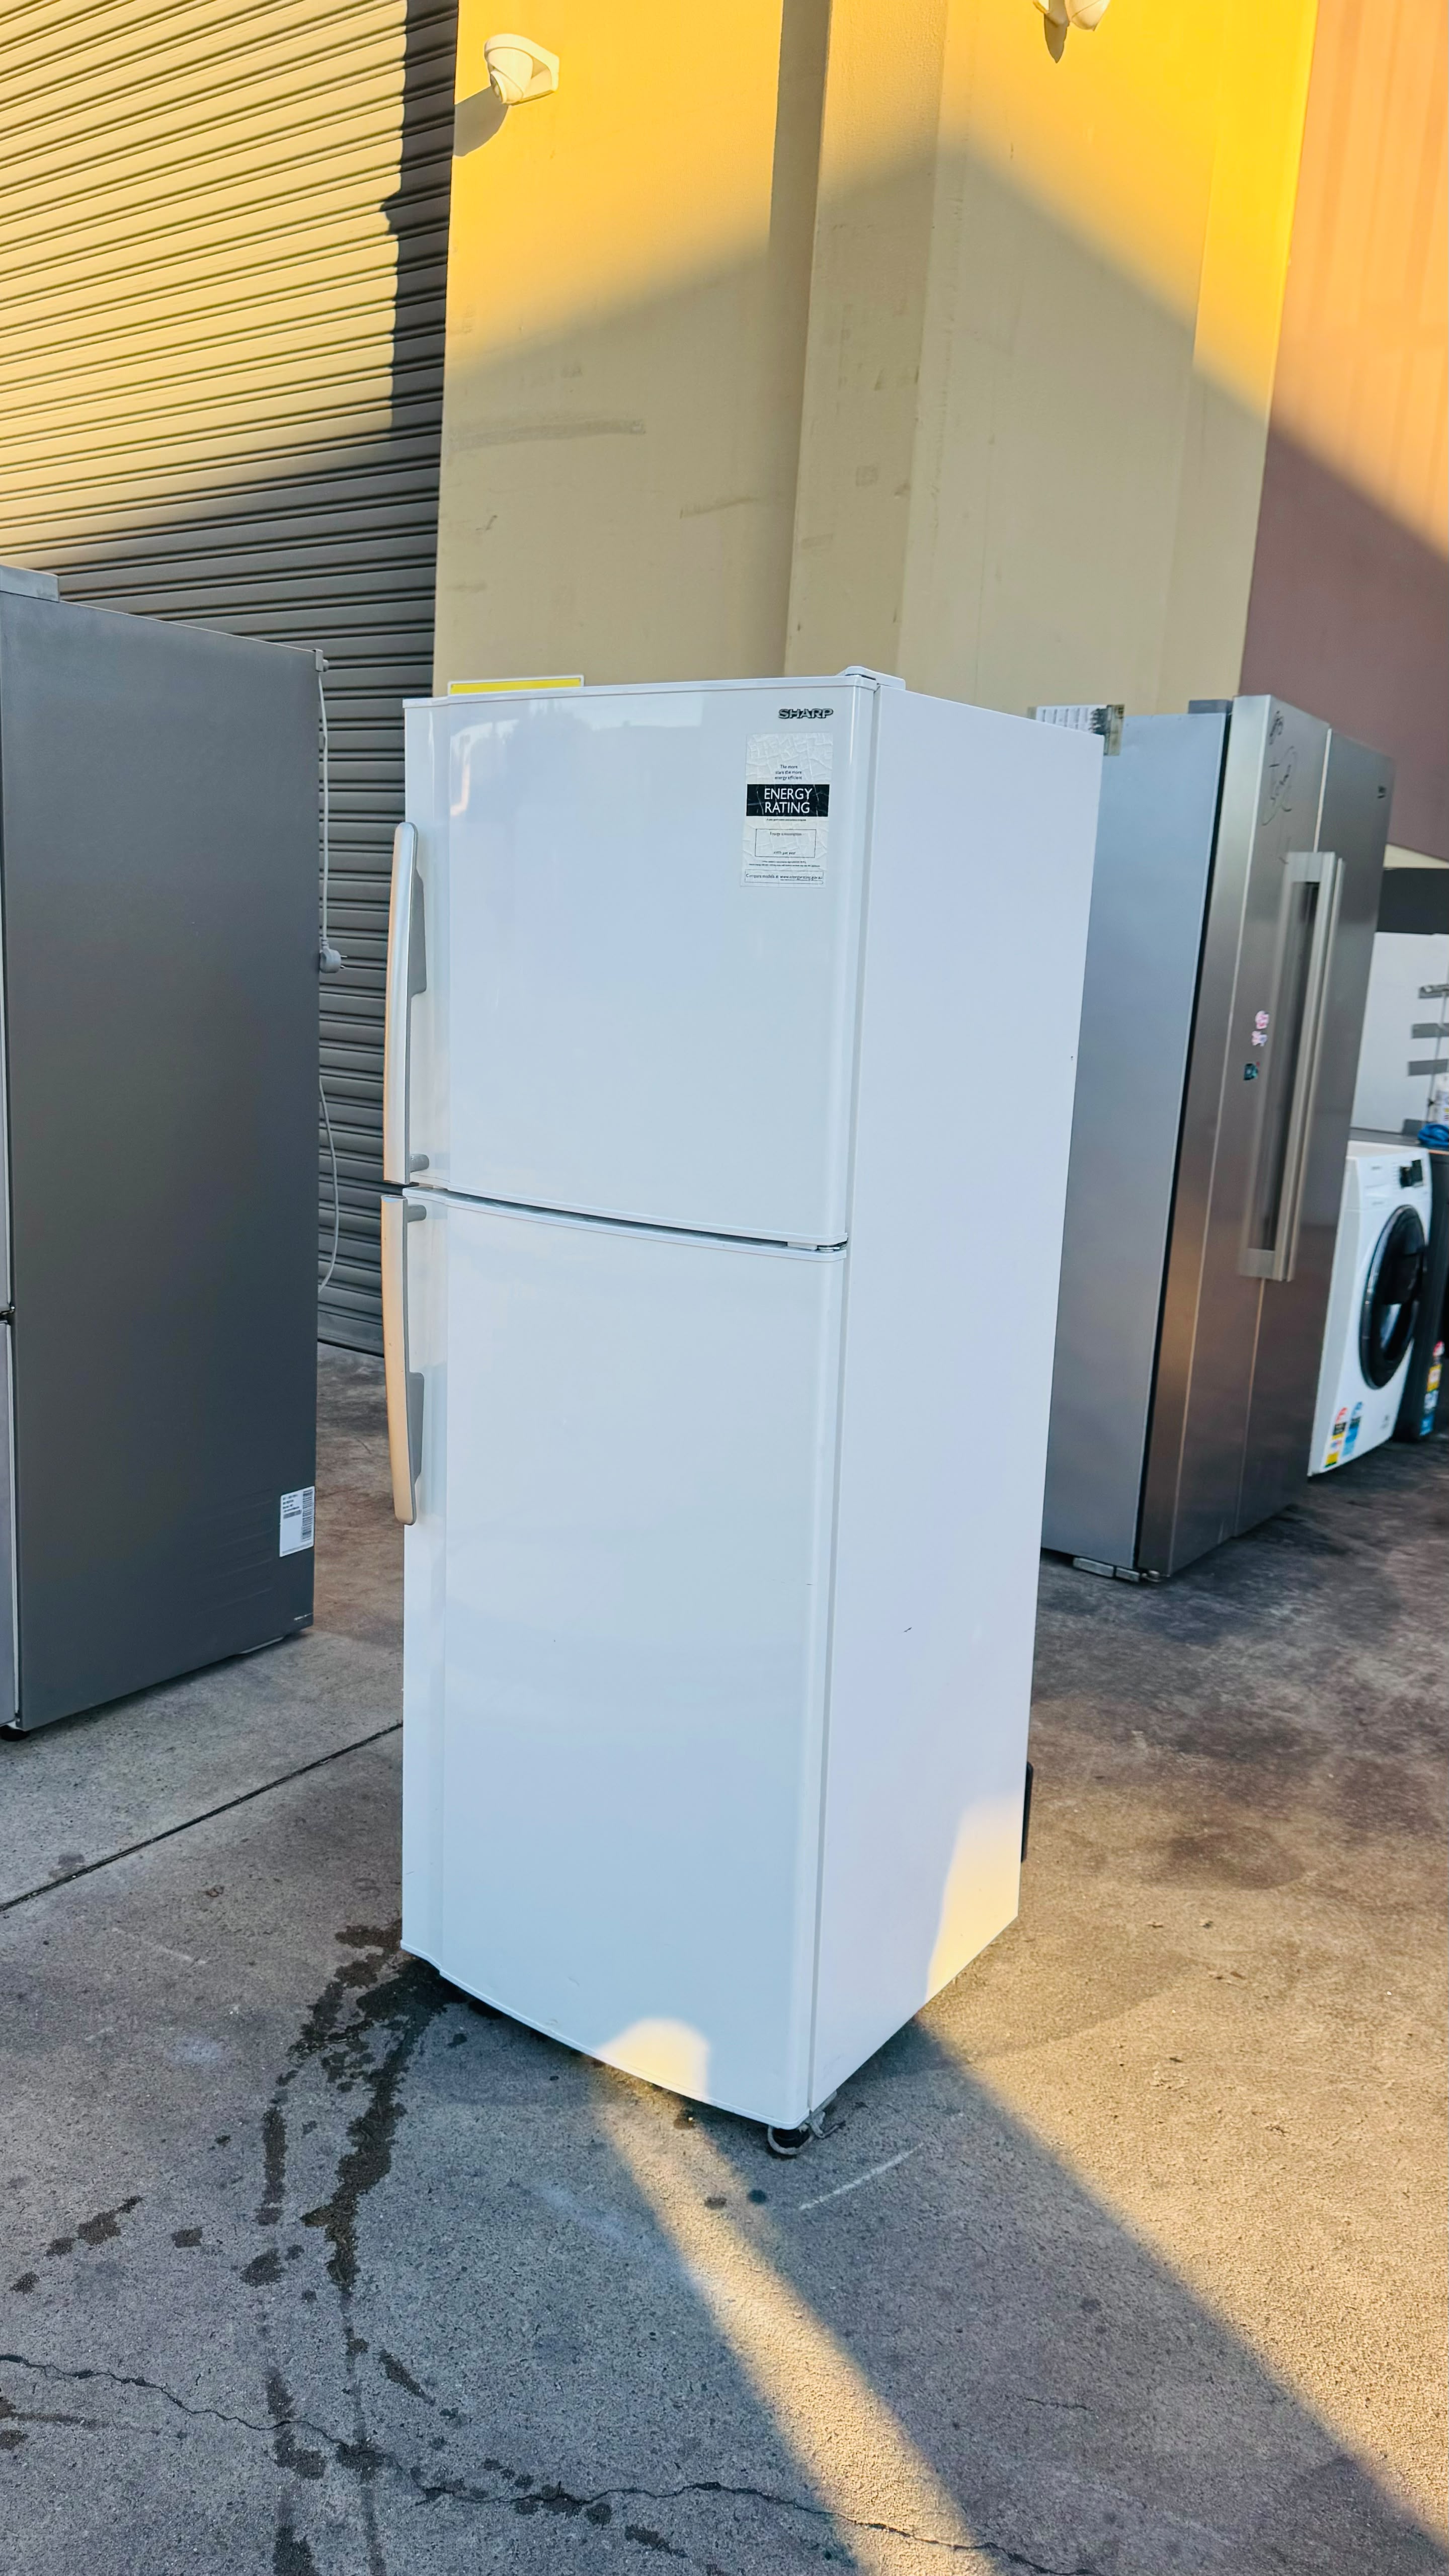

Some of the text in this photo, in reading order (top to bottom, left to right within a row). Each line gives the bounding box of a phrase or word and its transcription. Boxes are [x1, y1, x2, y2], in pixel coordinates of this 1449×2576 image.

[778, 708, 834, 719] SHARP
[764, 788, 813, 799] ENERGY
[765, 802, 810, 814] RATING
